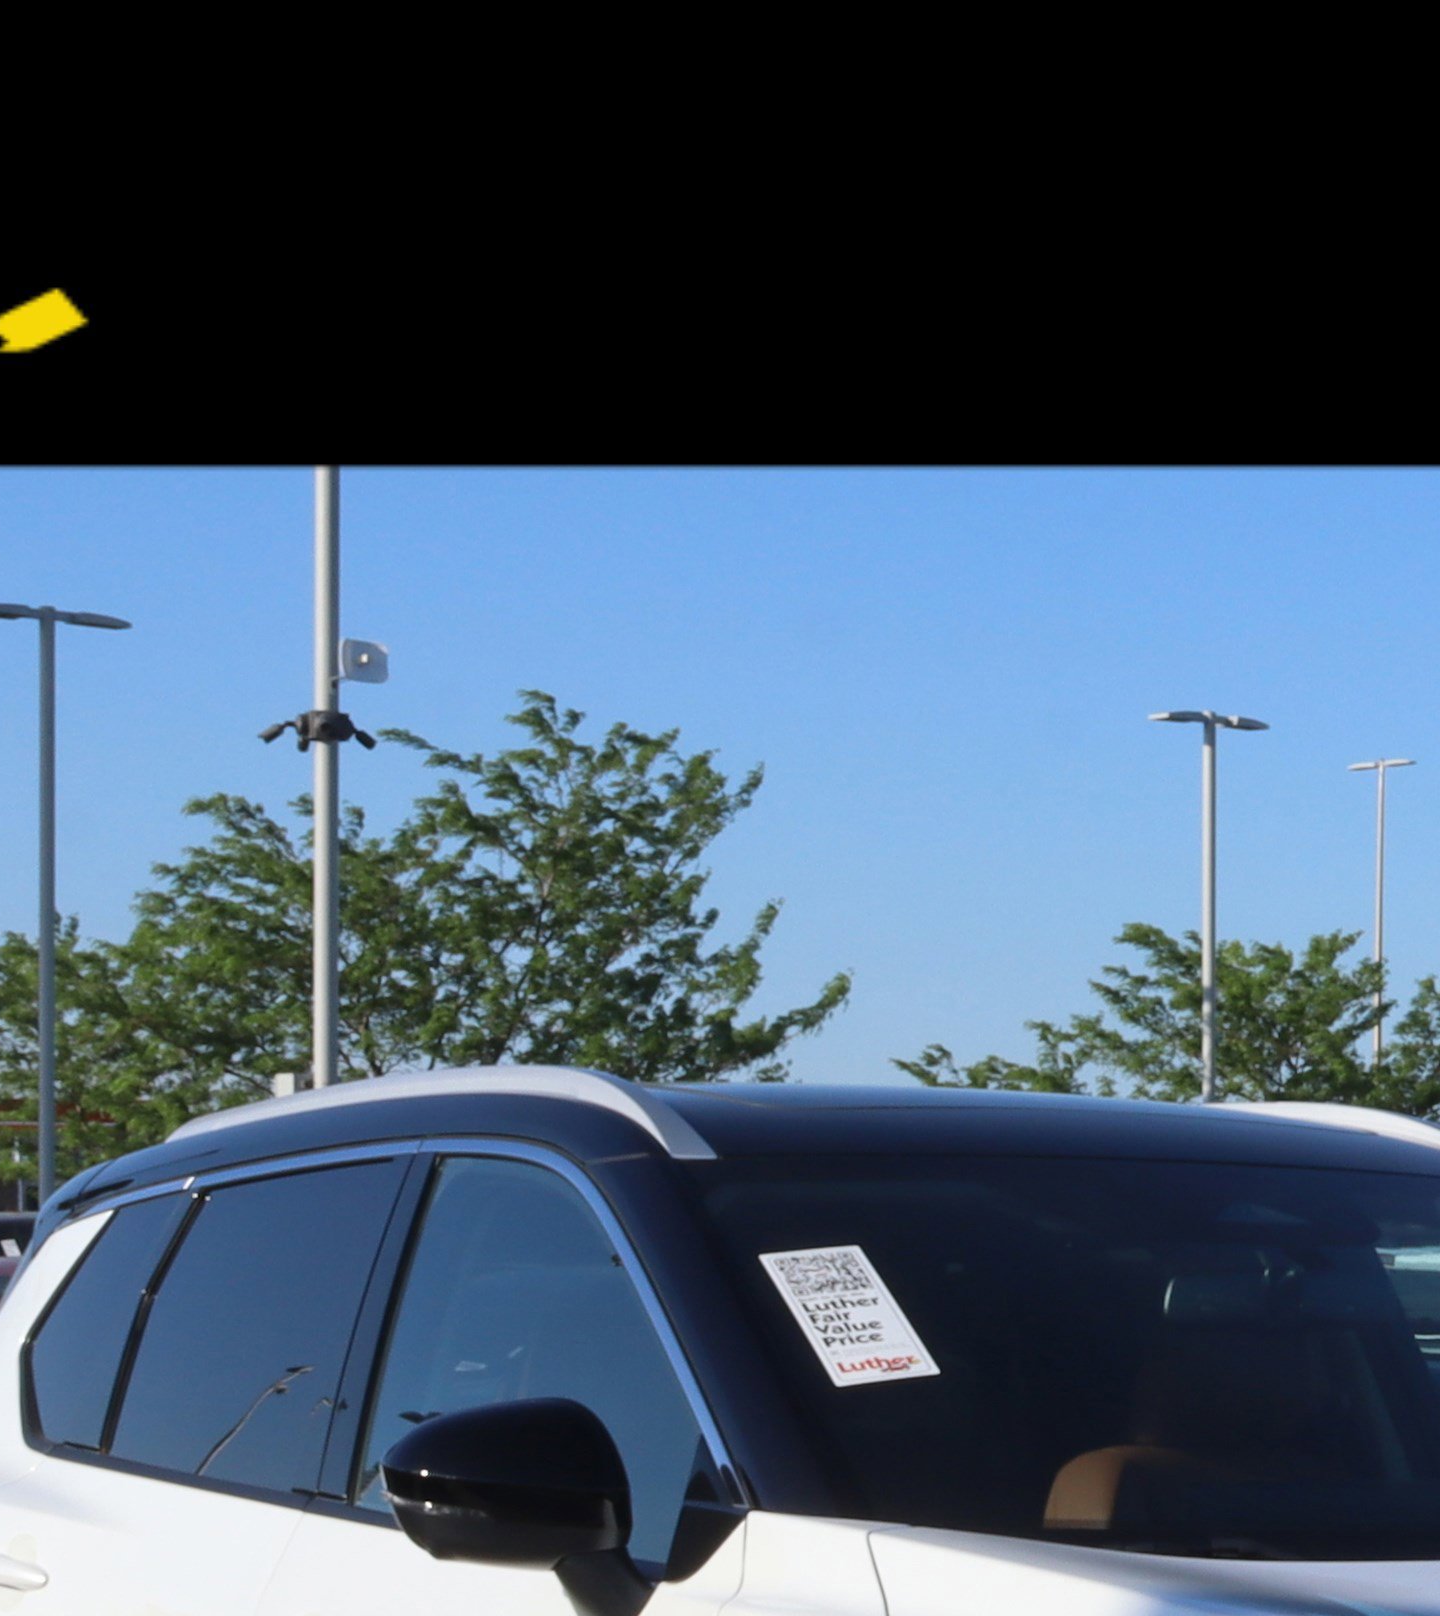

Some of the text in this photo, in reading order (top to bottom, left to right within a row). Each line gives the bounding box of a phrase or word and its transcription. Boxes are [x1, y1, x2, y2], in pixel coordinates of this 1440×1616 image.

[801, 1297, 879, 1313] Luther
[808, 1311, 850, 1324] Fair
[814, 1320, 883, 1334] Value
[823, 1333, 884, 1348] Price
[837, 1356, 914, 1373] Luther
